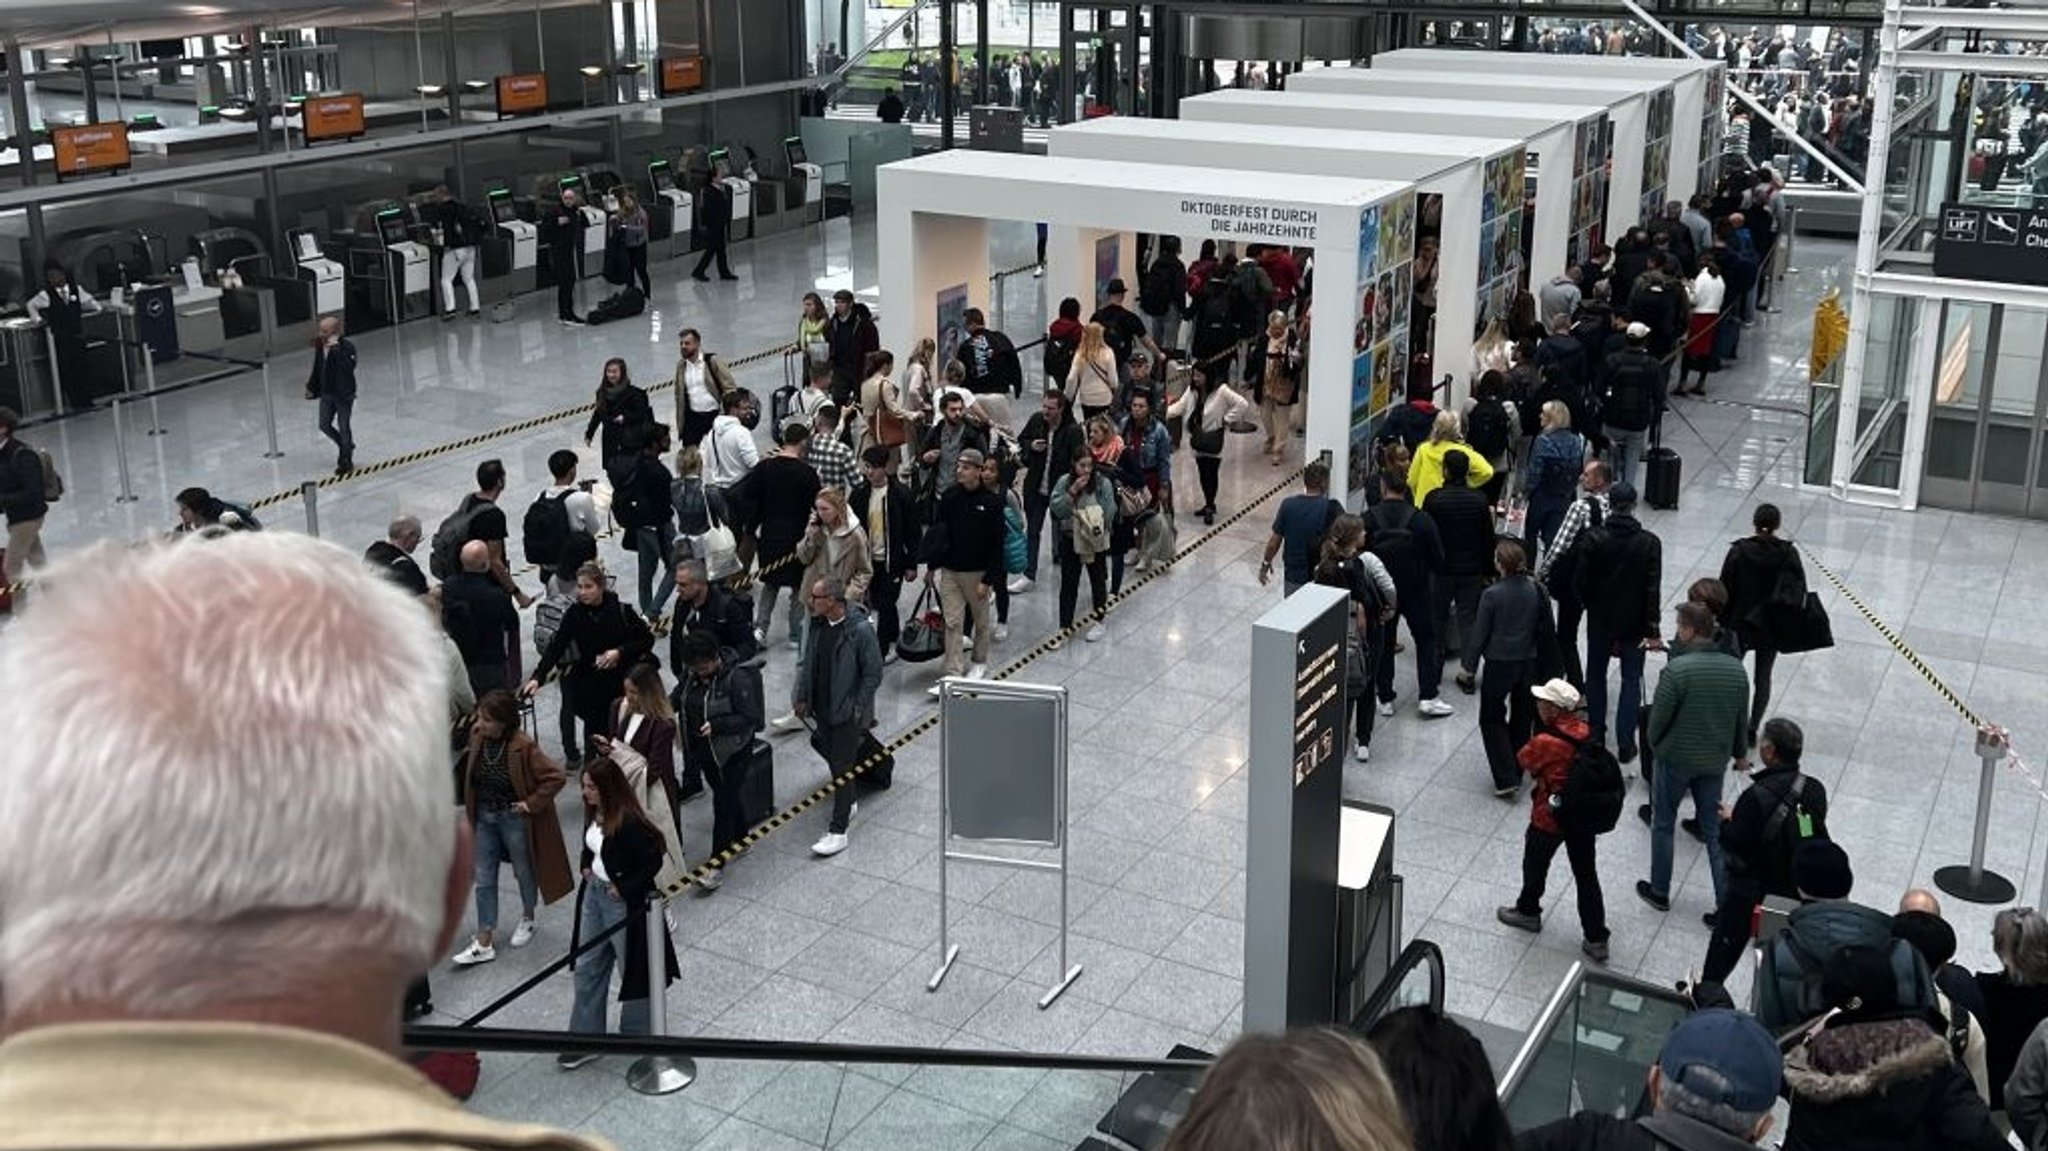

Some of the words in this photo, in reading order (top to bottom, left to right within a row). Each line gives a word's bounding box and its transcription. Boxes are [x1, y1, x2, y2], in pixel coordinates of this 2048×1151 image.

[1181, 201, 1268, 219] OKTOBERFEST
[1272, 208, 1317, 223] DURCH
[1212, 219, 1231, 232] DIE
[1234, 222, 1317, 239] JAHRZEHNTE
[1949, 219, 1975, 230] LIFT
